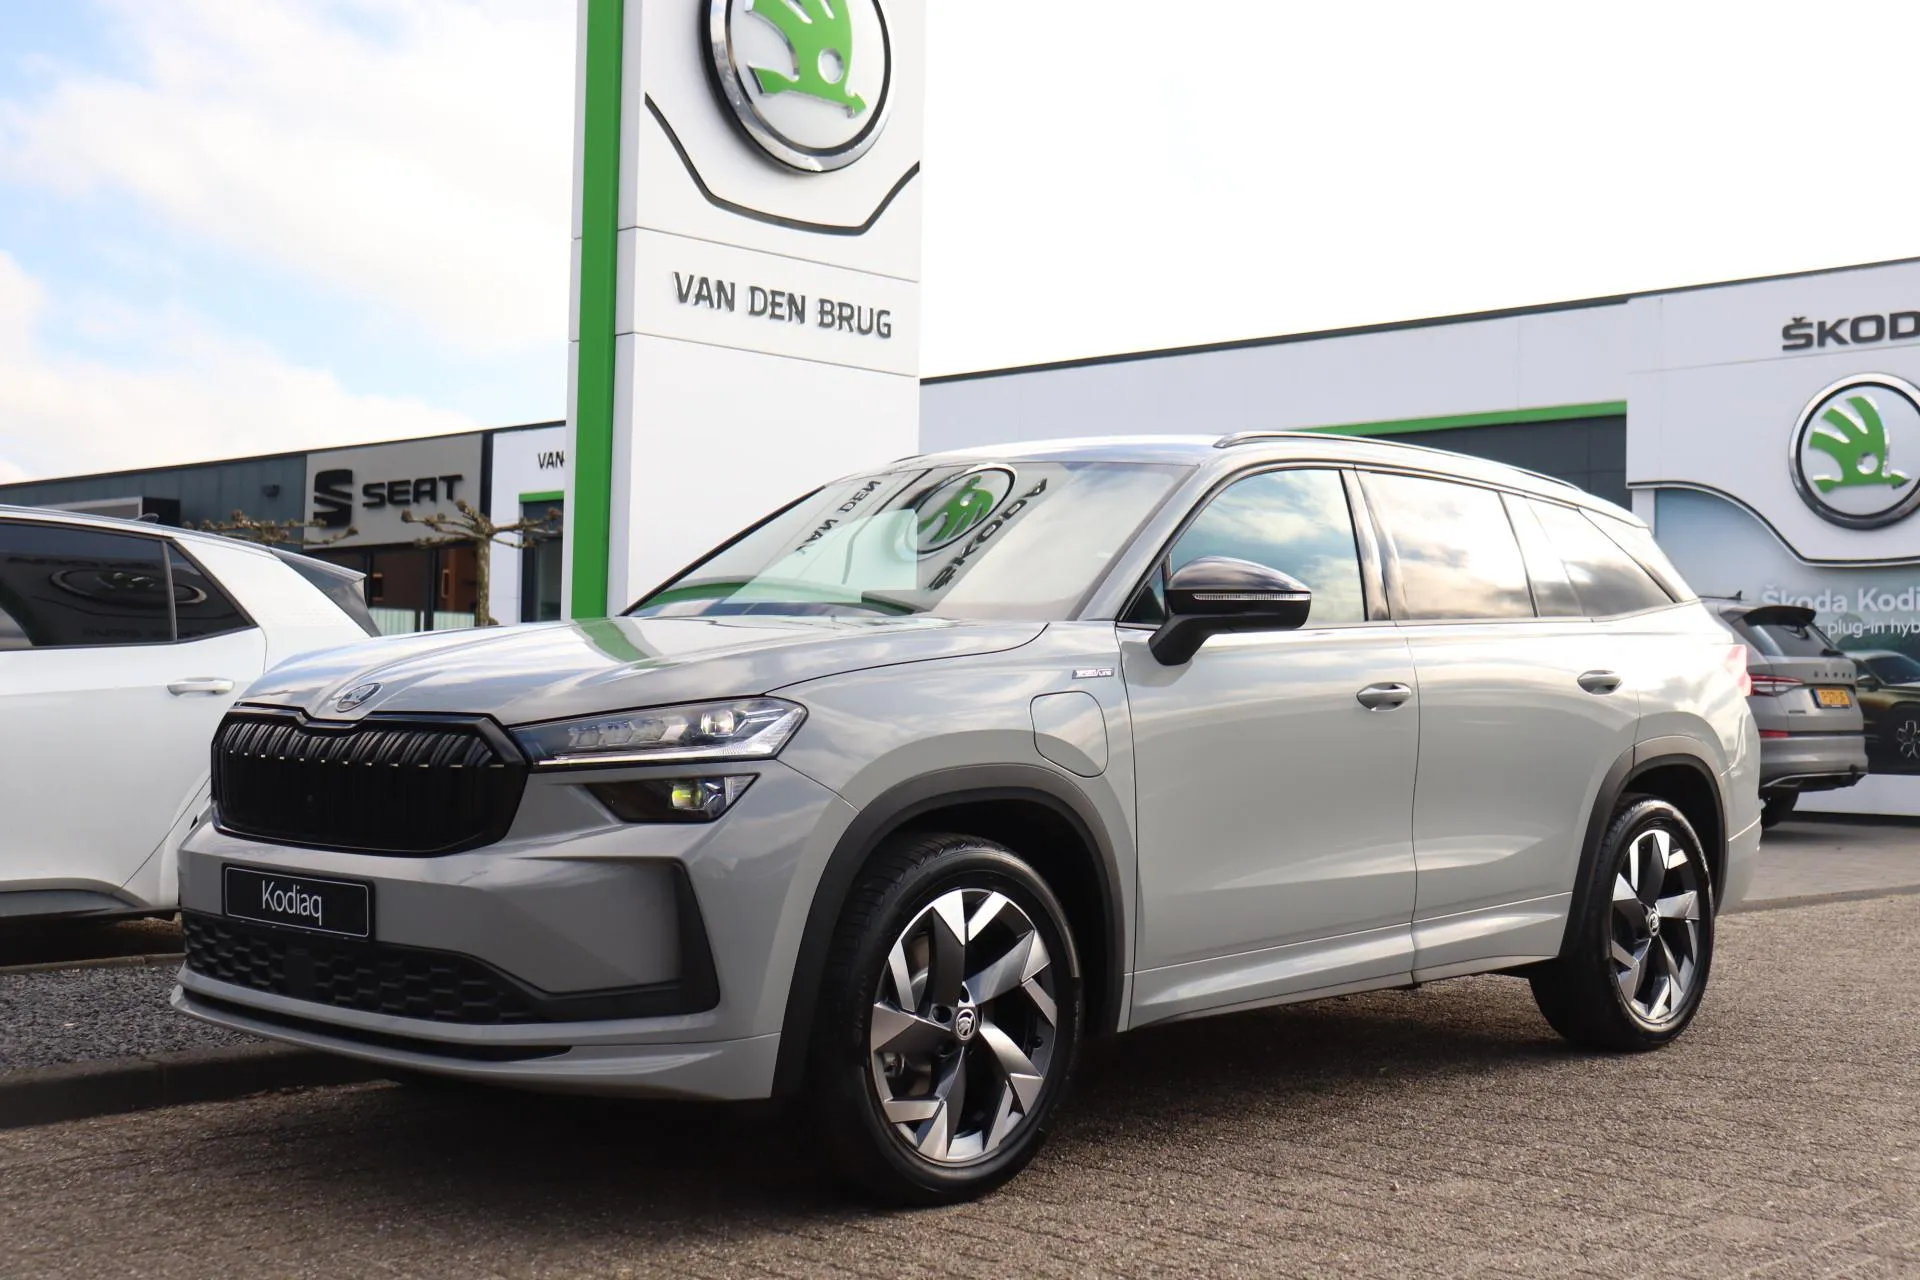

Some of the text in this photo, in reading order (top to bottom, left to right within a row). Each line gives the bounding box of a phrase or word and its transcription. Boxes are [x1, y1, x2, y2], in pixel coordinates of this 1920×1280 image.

[673, 272, 892, 339] VAN DEN BRUG
[1782, 310, 1920, 351] ŠKOD
[538, 450, 565, 469] VAN
[362, 474, 463, 508] SEAT
[1827, 618, 1885, 638] plug-in
[262, 880, 322, 926] Kodiaq
